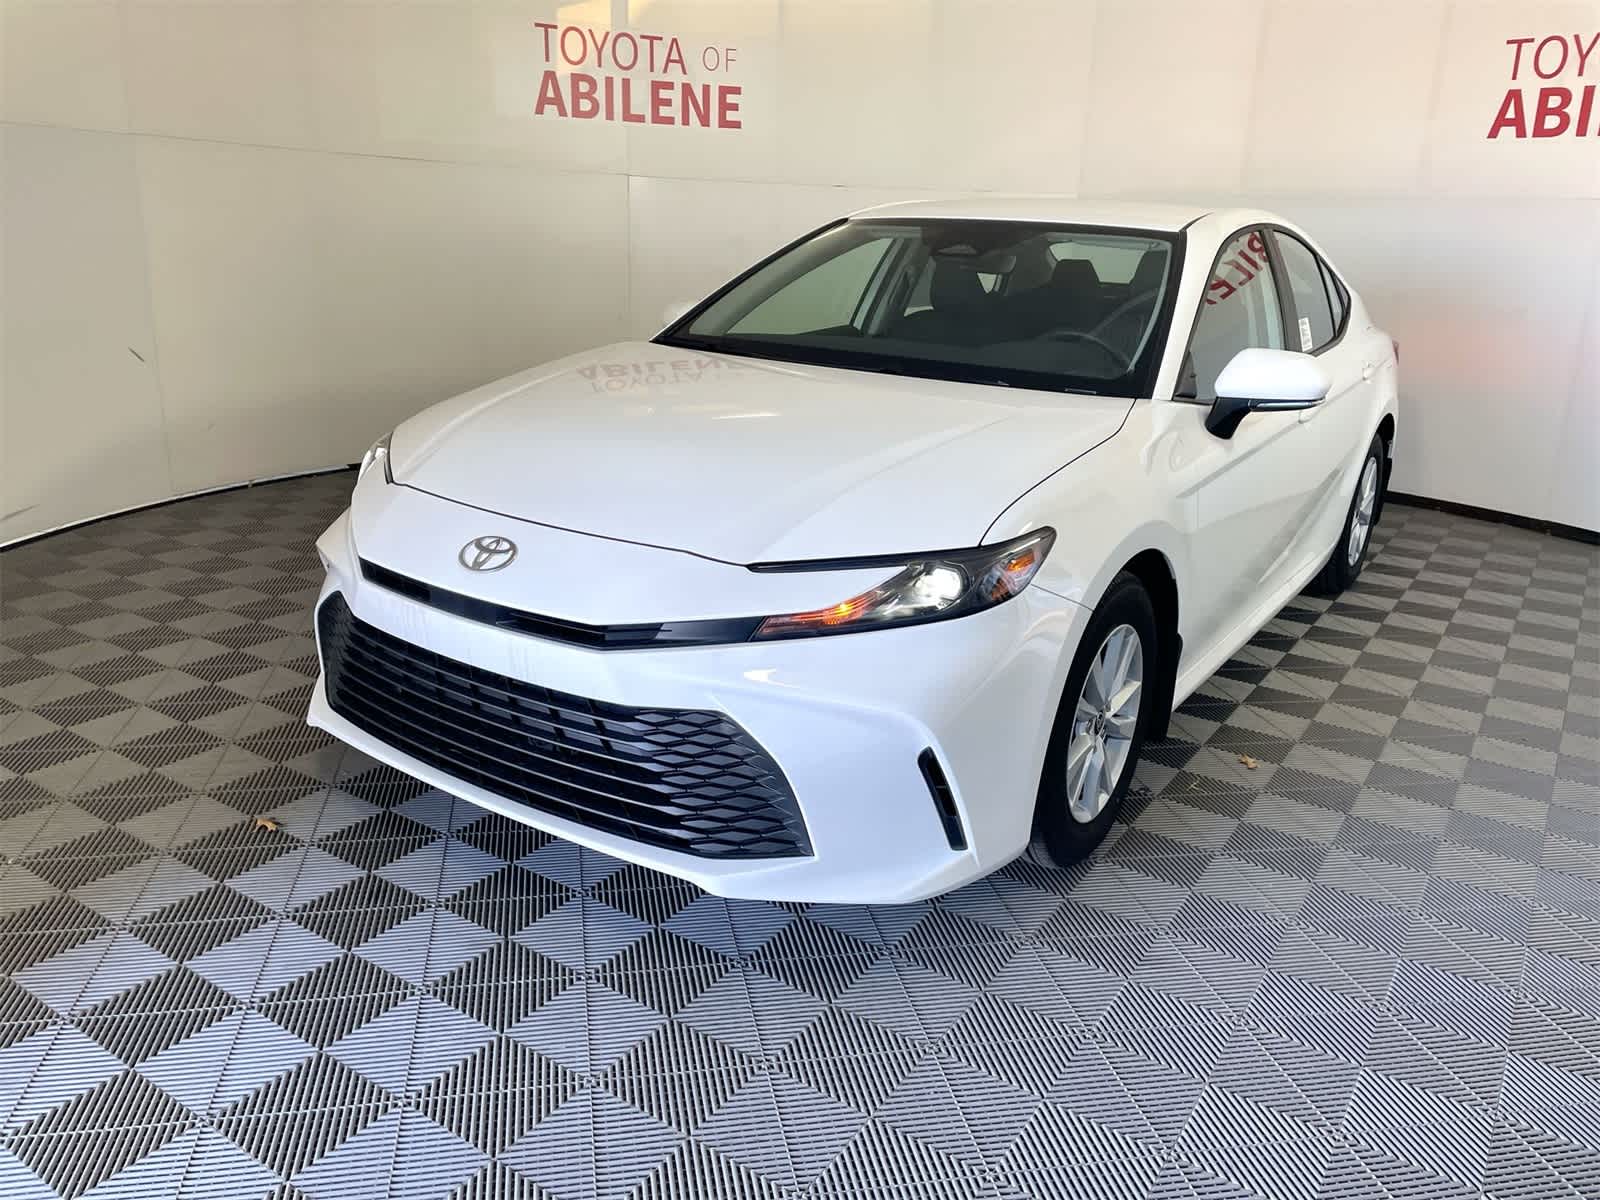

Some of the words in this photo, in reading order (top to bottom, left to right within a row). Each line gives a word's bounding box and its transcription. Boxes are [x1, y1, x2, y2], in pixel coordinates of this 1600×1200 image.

[534, 22, 687, 75] TOYOTA
[702, 46, 737, 72] OF
[534, 70, 742, 129] ABILENE
[1486, 85, 1600, 139] ABI
